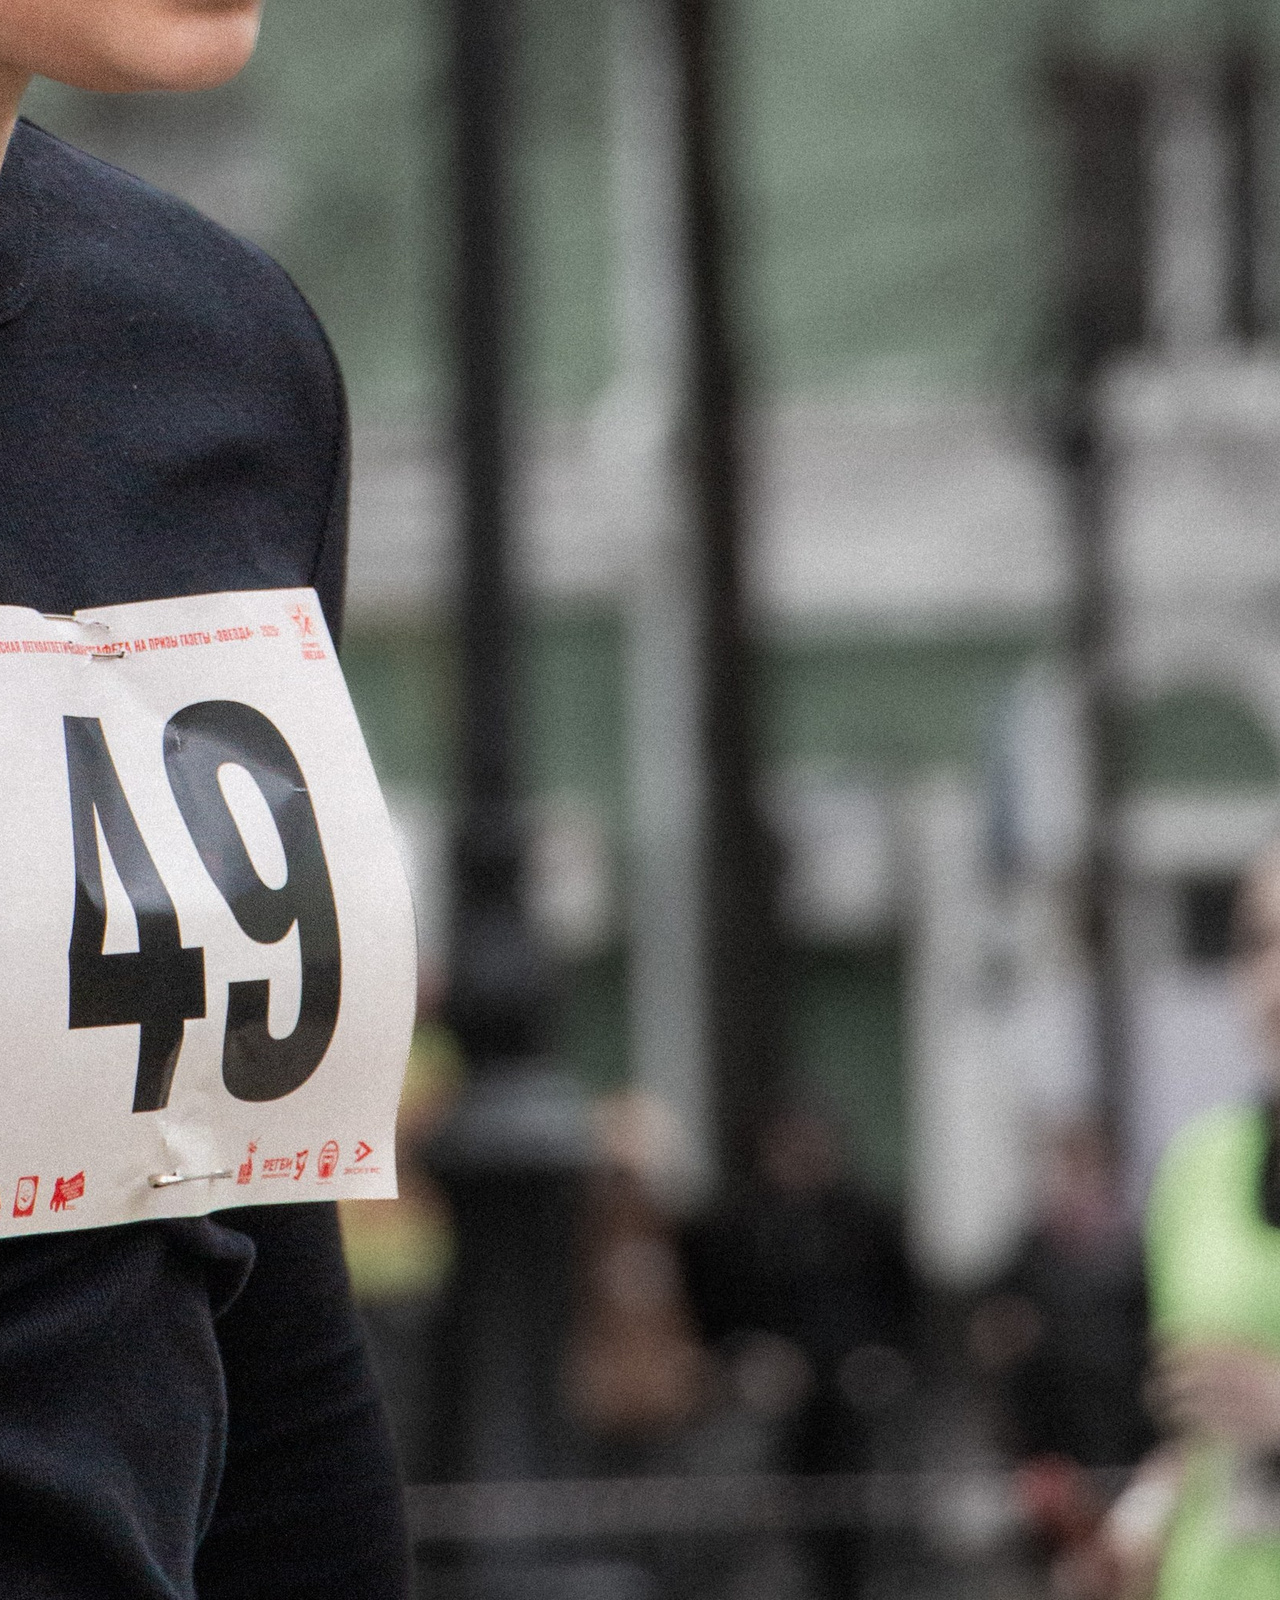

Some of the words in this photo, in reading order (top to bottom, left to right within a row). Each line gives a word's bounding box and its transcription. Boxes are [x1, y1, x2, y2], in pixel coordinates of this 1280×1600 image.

[134, 639, 147, 652] НА
[148, 635, 178, 651] ПРИЗЫ
[179, 631, 211, 647] ГАЗЕТЫ
[63, 700, 341, 1113] 49
